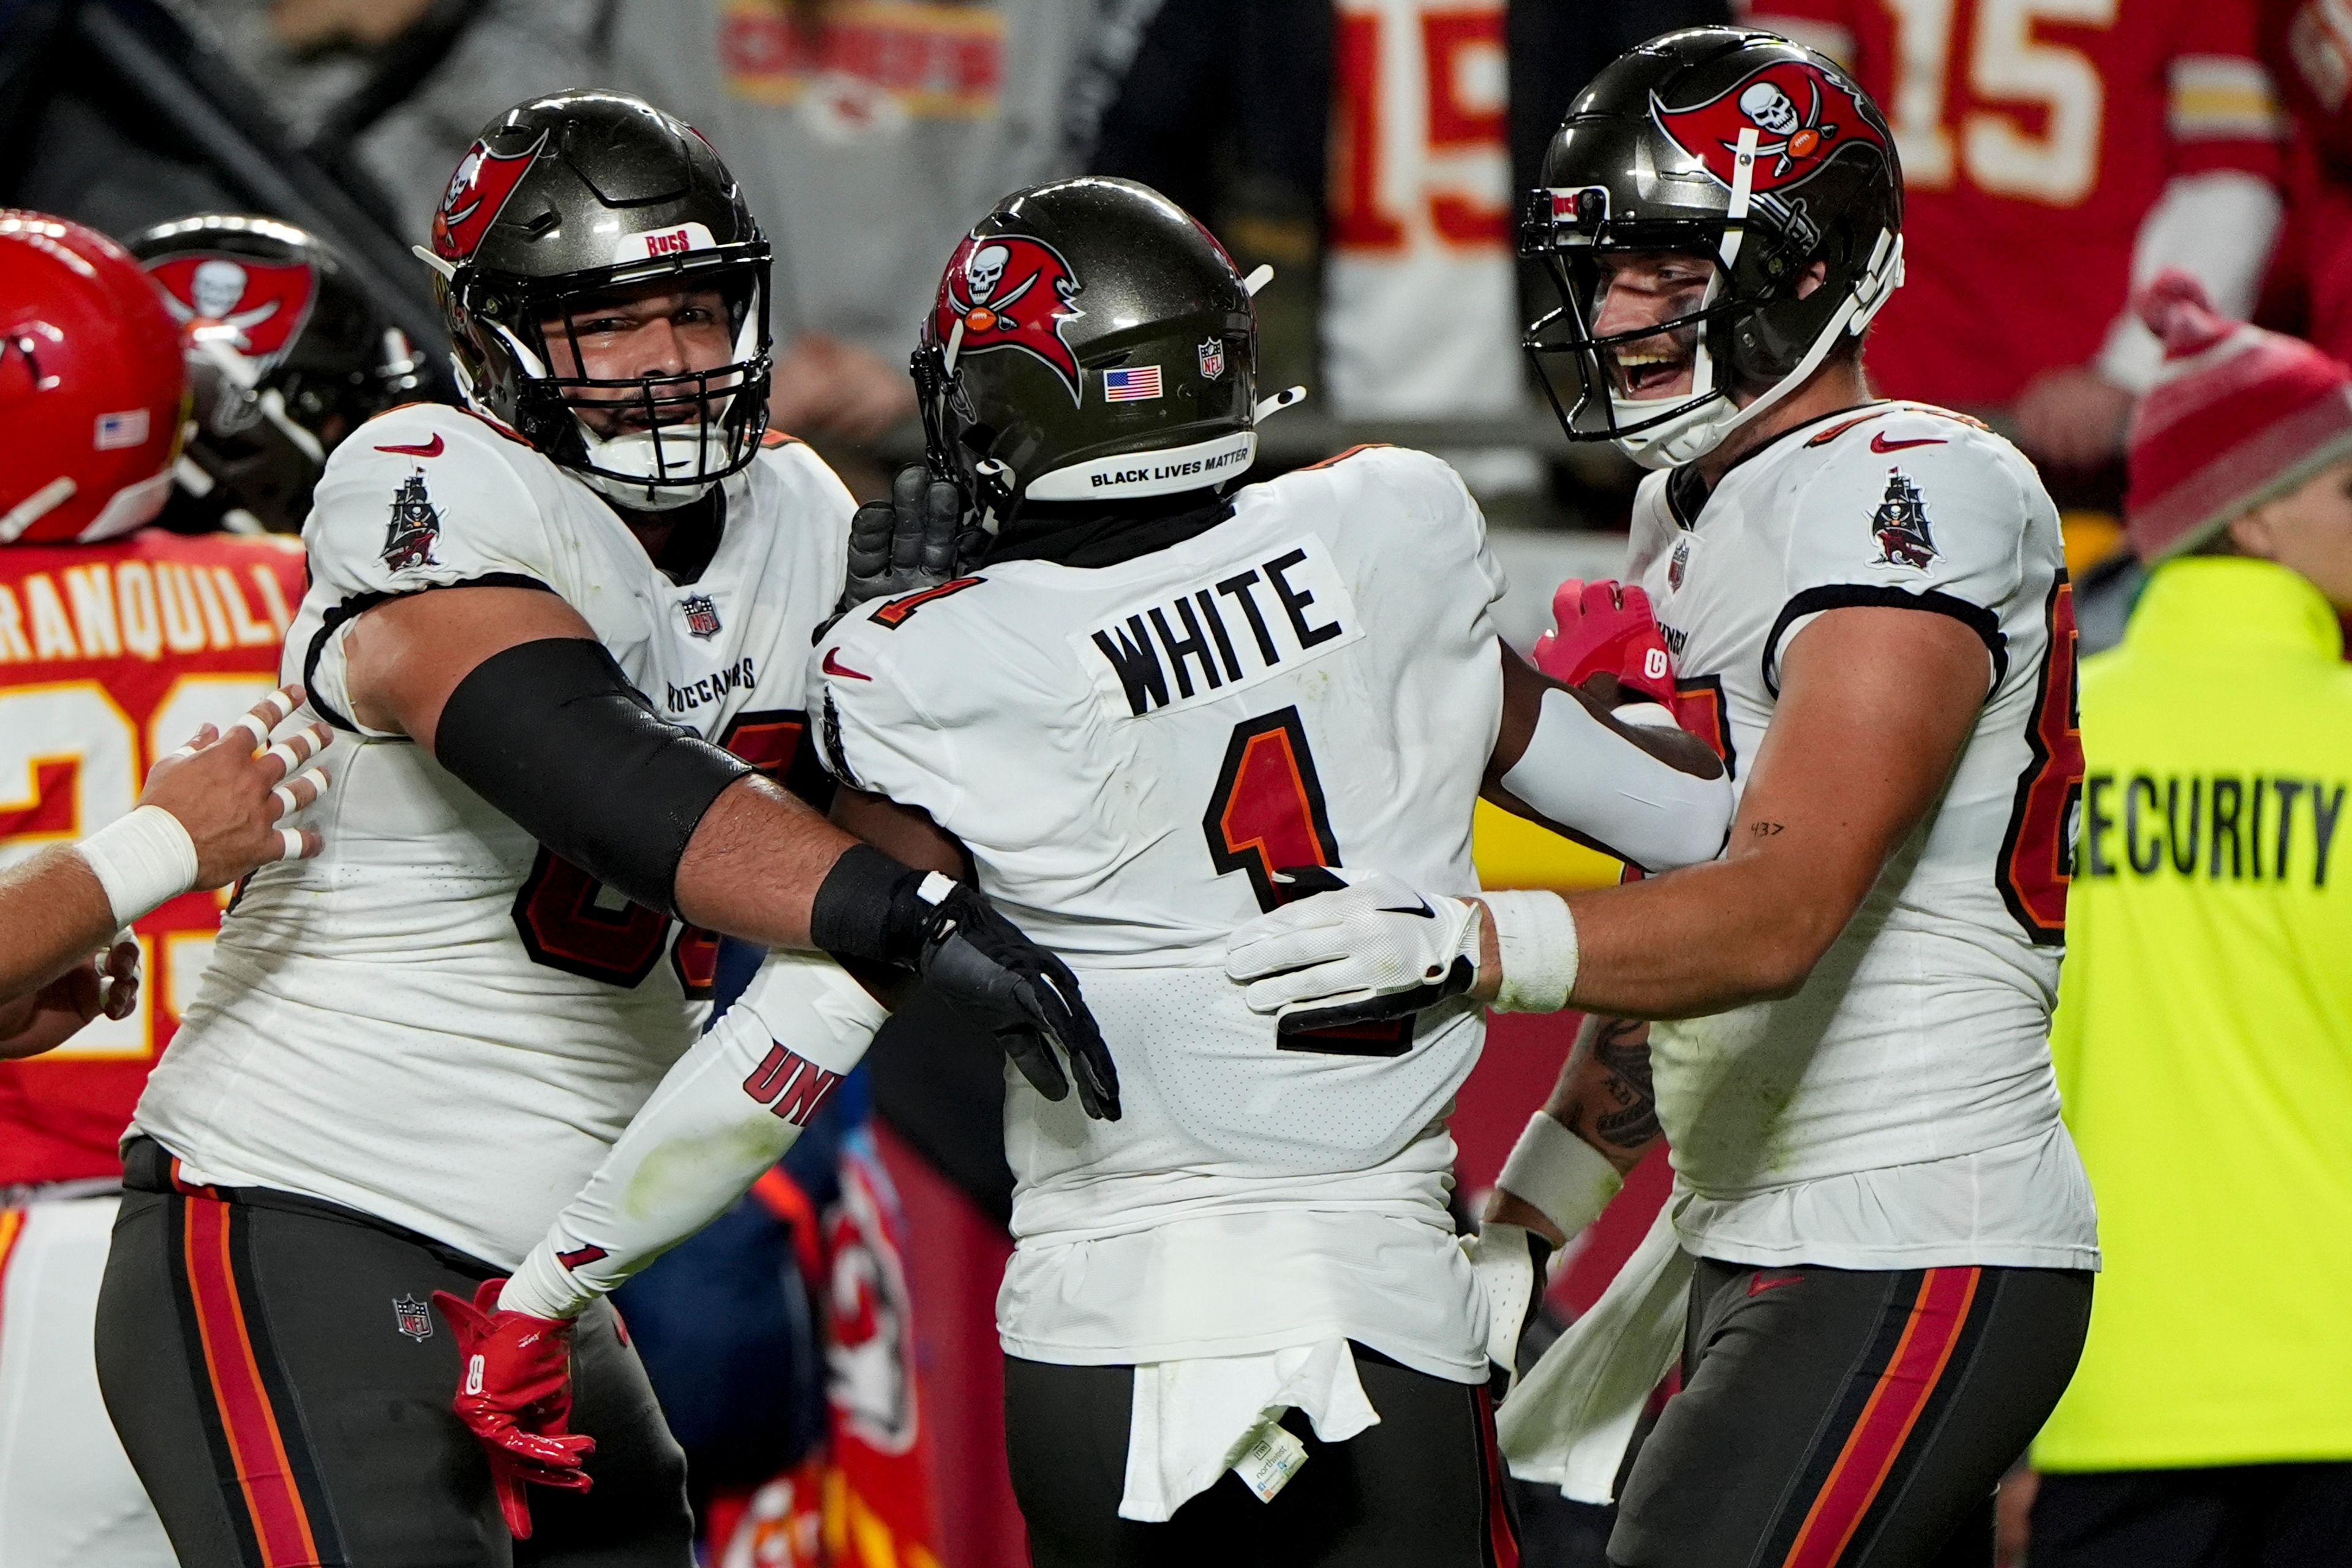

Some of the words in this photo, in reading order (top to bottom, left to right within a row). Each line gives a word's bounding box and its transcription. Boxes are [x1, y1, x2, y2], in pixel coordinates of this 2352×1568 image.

[1888, 0, 2120, 209] 15
[1202, 355, 1222, 376] NFL
[1091, 469, 1150, 487] BLACK
[1155, 461, 1202, 480] LIVES
[1204, 447, 1248, 471] MATTER
[690, 612, 718, 633] NFL
[1090, 547, 1343, 717] WHITE
[2071, 774, 2346, 891] ECURITY
[1202, 704, 1417, 1057] 1
[403, 1316, 429, 1333] NFL
[1256, 1445, 1287, 1479] northwest
